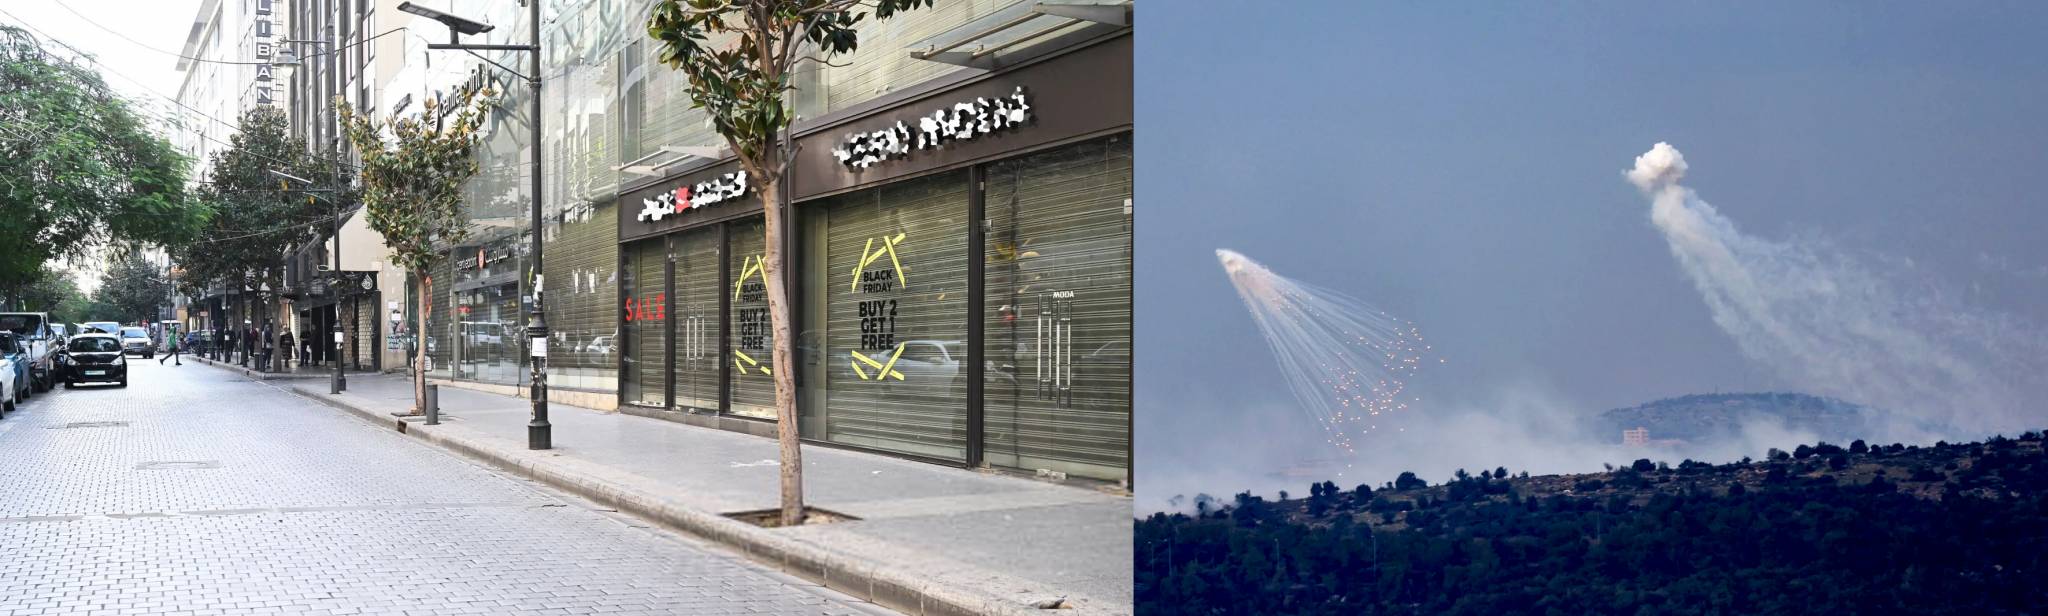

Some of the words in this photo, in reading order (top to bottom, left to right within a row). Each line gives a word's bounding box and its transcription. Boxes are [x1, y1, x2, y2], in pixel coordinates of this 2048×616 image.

[863, 269, 893, 283] BLACK
[743, 284, 762, 293] BLACK
[863, 281, 893, 294] FRIDAY
[1053, 290, 1075, 298] MODA
[743, 293, 763, 303] FRIDAY
[625, 293, 665, 321] SALE
[858, 301, 886, 317] BUY
[889, 300, 897, 316] 2
[740, 308, 758, 322] BUY
[760, 307, 766, 321] 2
[741, 323, 758, 336] GET
[760, 322, 764, 335] 1
[860, 317, 886, 334] GET
[889, 316, 895, 332] 1
[742, 336, 764, 350] FREE
[861, 334, 894, 350] FREE
